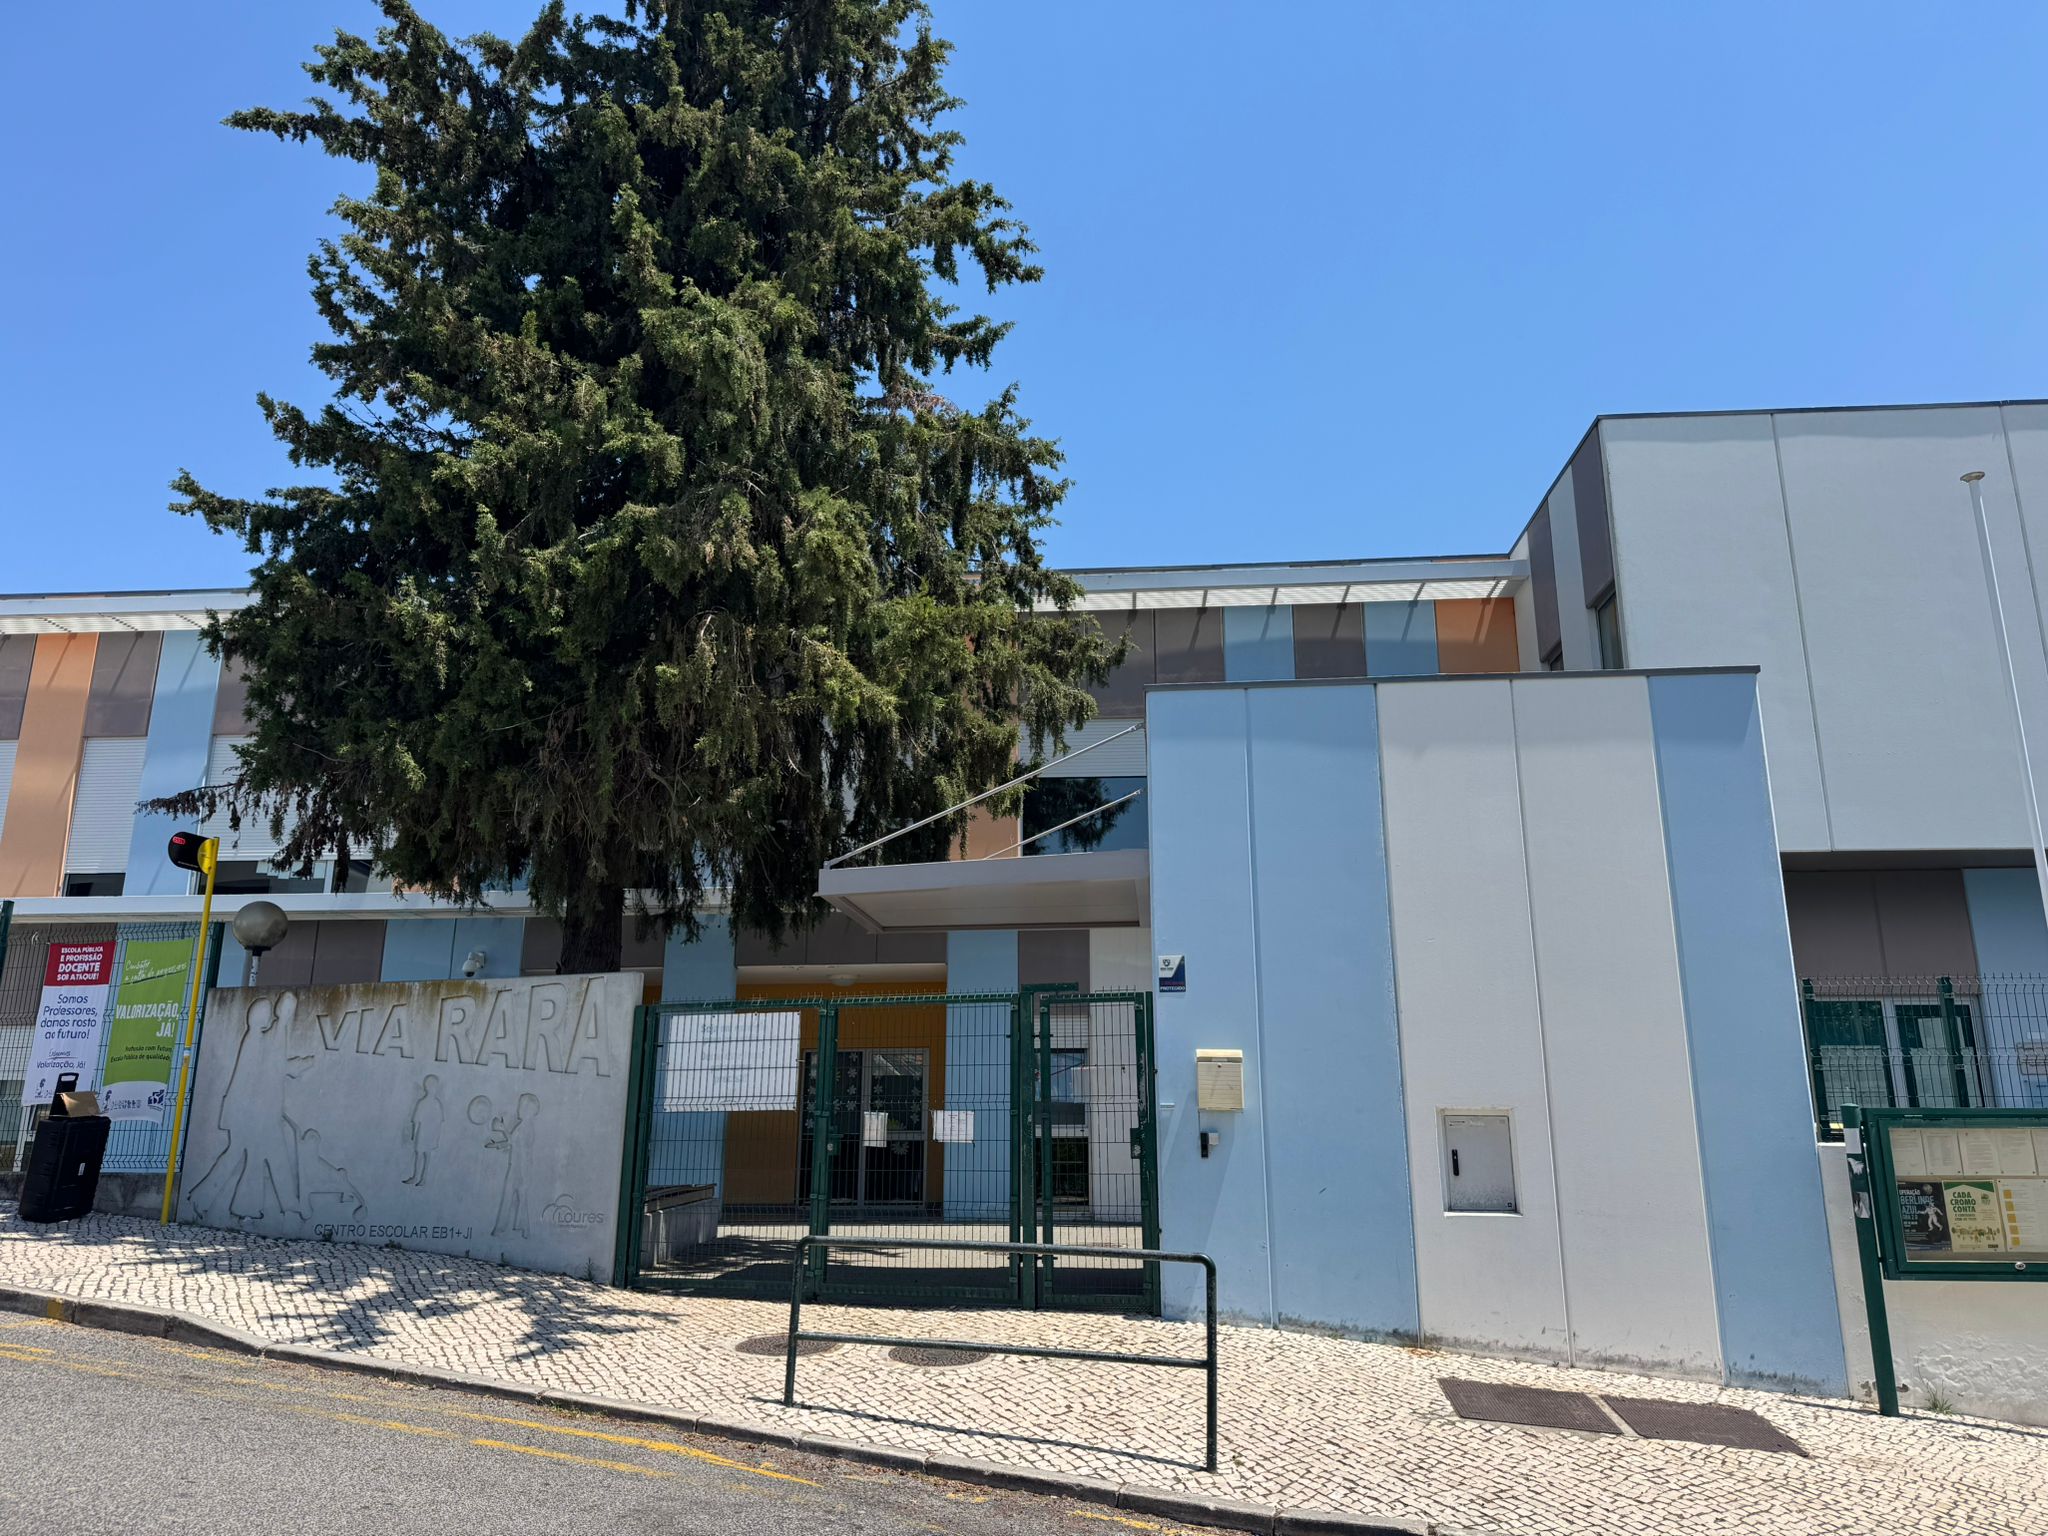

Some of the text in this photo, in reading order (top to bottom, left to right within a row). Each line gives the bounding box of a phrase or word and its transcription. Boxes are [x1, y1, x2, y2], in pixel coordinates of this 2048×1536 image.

[65, 953, 103, 962] PROFISSÃO
[58, 962, 101, 973] DOCENTE
[57, 993, 89, 1004] Somos
[43, 1005, 98, 1017] Professores,
[116, 1000, 180, 1021] VALORIZAÇÃO,
[71, 1017, 97, 1028] rosto
[155, 1018, 176, 1038] JÁ!
[316, 976, 611, 1078] VIA RARA
[57, 1028, 91, 1040] futuro!
[36, 1060, 75, 1070] Valorização,
[1952, 1191, 1972, 1199] CADA
[1950, 1198, 1976, 1206] CROMO
[557, 1211, 605, 1224] Loures
[313, 1223, 366, 1237] CENTRO
[369, 1224, 428, 1239] ESCOLAR
